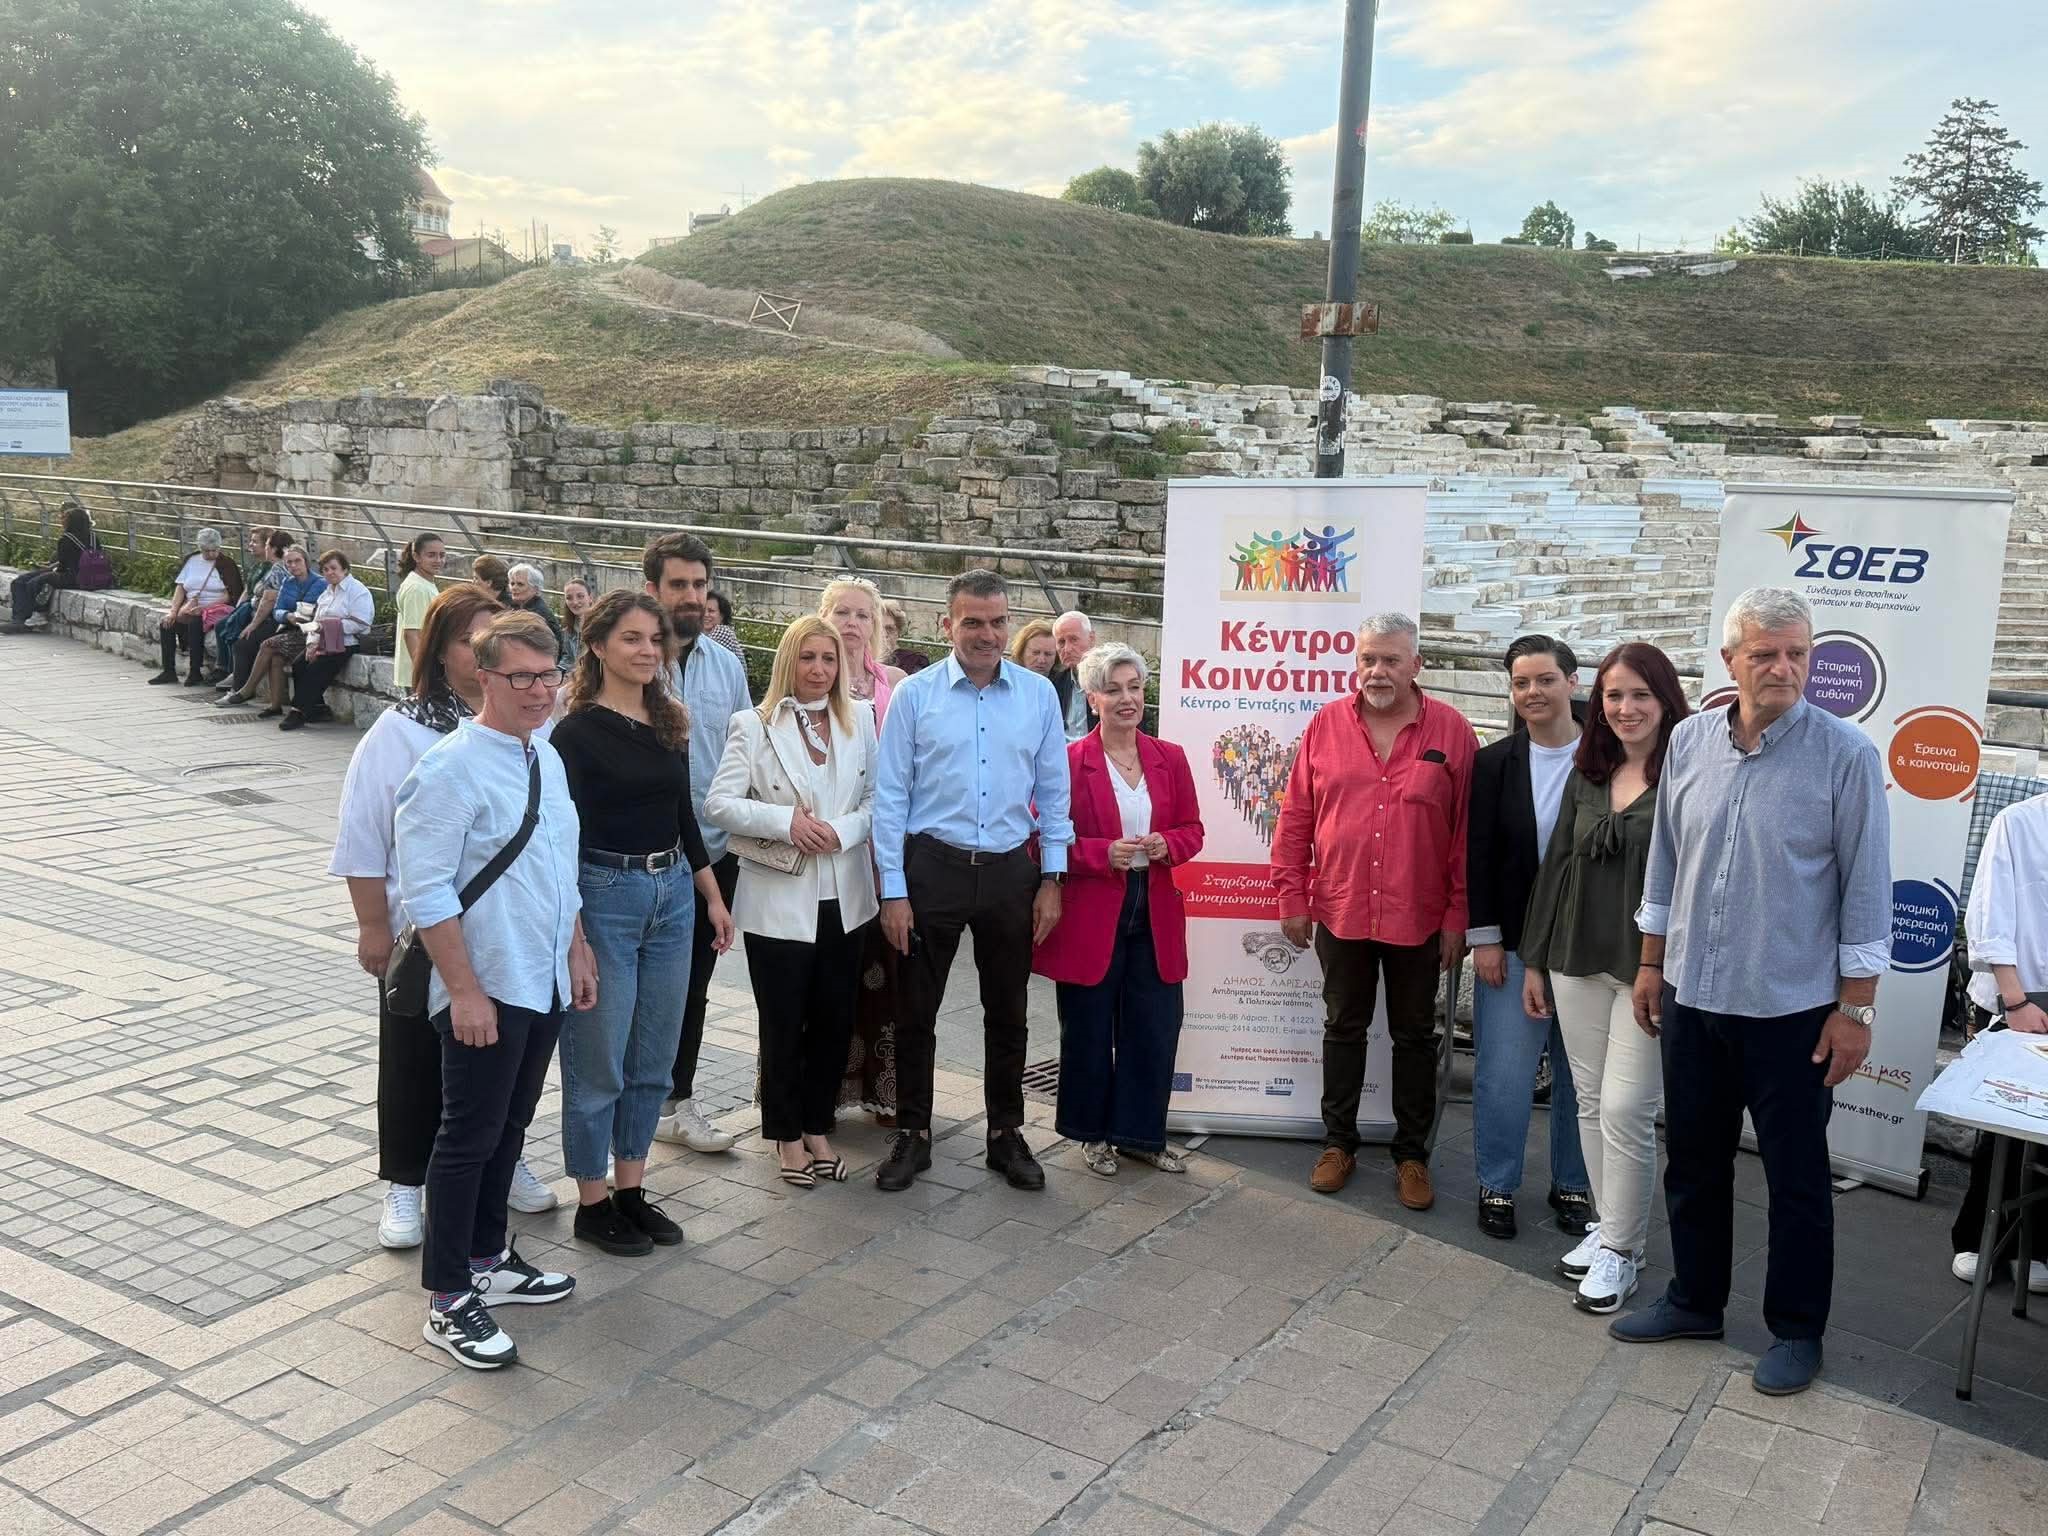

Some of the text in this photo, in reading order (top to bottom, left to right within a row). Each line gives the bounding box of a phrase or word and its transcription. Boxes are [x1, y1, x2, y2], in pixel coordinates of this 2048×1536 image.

[1794, 543, 1930, 584] ΣΘΕΒ
[1805, 585, 1909, 600] Σύνδεσμος Θεσσαλικών
[1849, 600, 1863, 608] και
[1864, 600, 1921, 612] Βιομηχανιών
[1220, 620, 1356, 661] Κέντρο
[1181, 658, 1361, 694] Κοινότητα
[1816, 659, 1861, 676] Εταιρική
[1811, 675, 1863, 690] κοινωνική
[1815, 688, 1855, 703] ευθύνη
[1180, 696, 1231, 712] Κέντρο
[1234, 697, 1296, 714] Ένταξης
[1913, 743, 1957, 757] Έρευνα
[1896, 755, 1971, 774] & καινοτομία
[1186, 890, 1278, 908] Δυναμώνουμε
[1893, 902, 1940, 920] υναμική
[1893, 916, 1949, 936] ιφερειακή
[1223, 976, 1266, 988] ΔΗΜΟΣ
[1877, 1064, 1912, 1085] μας
